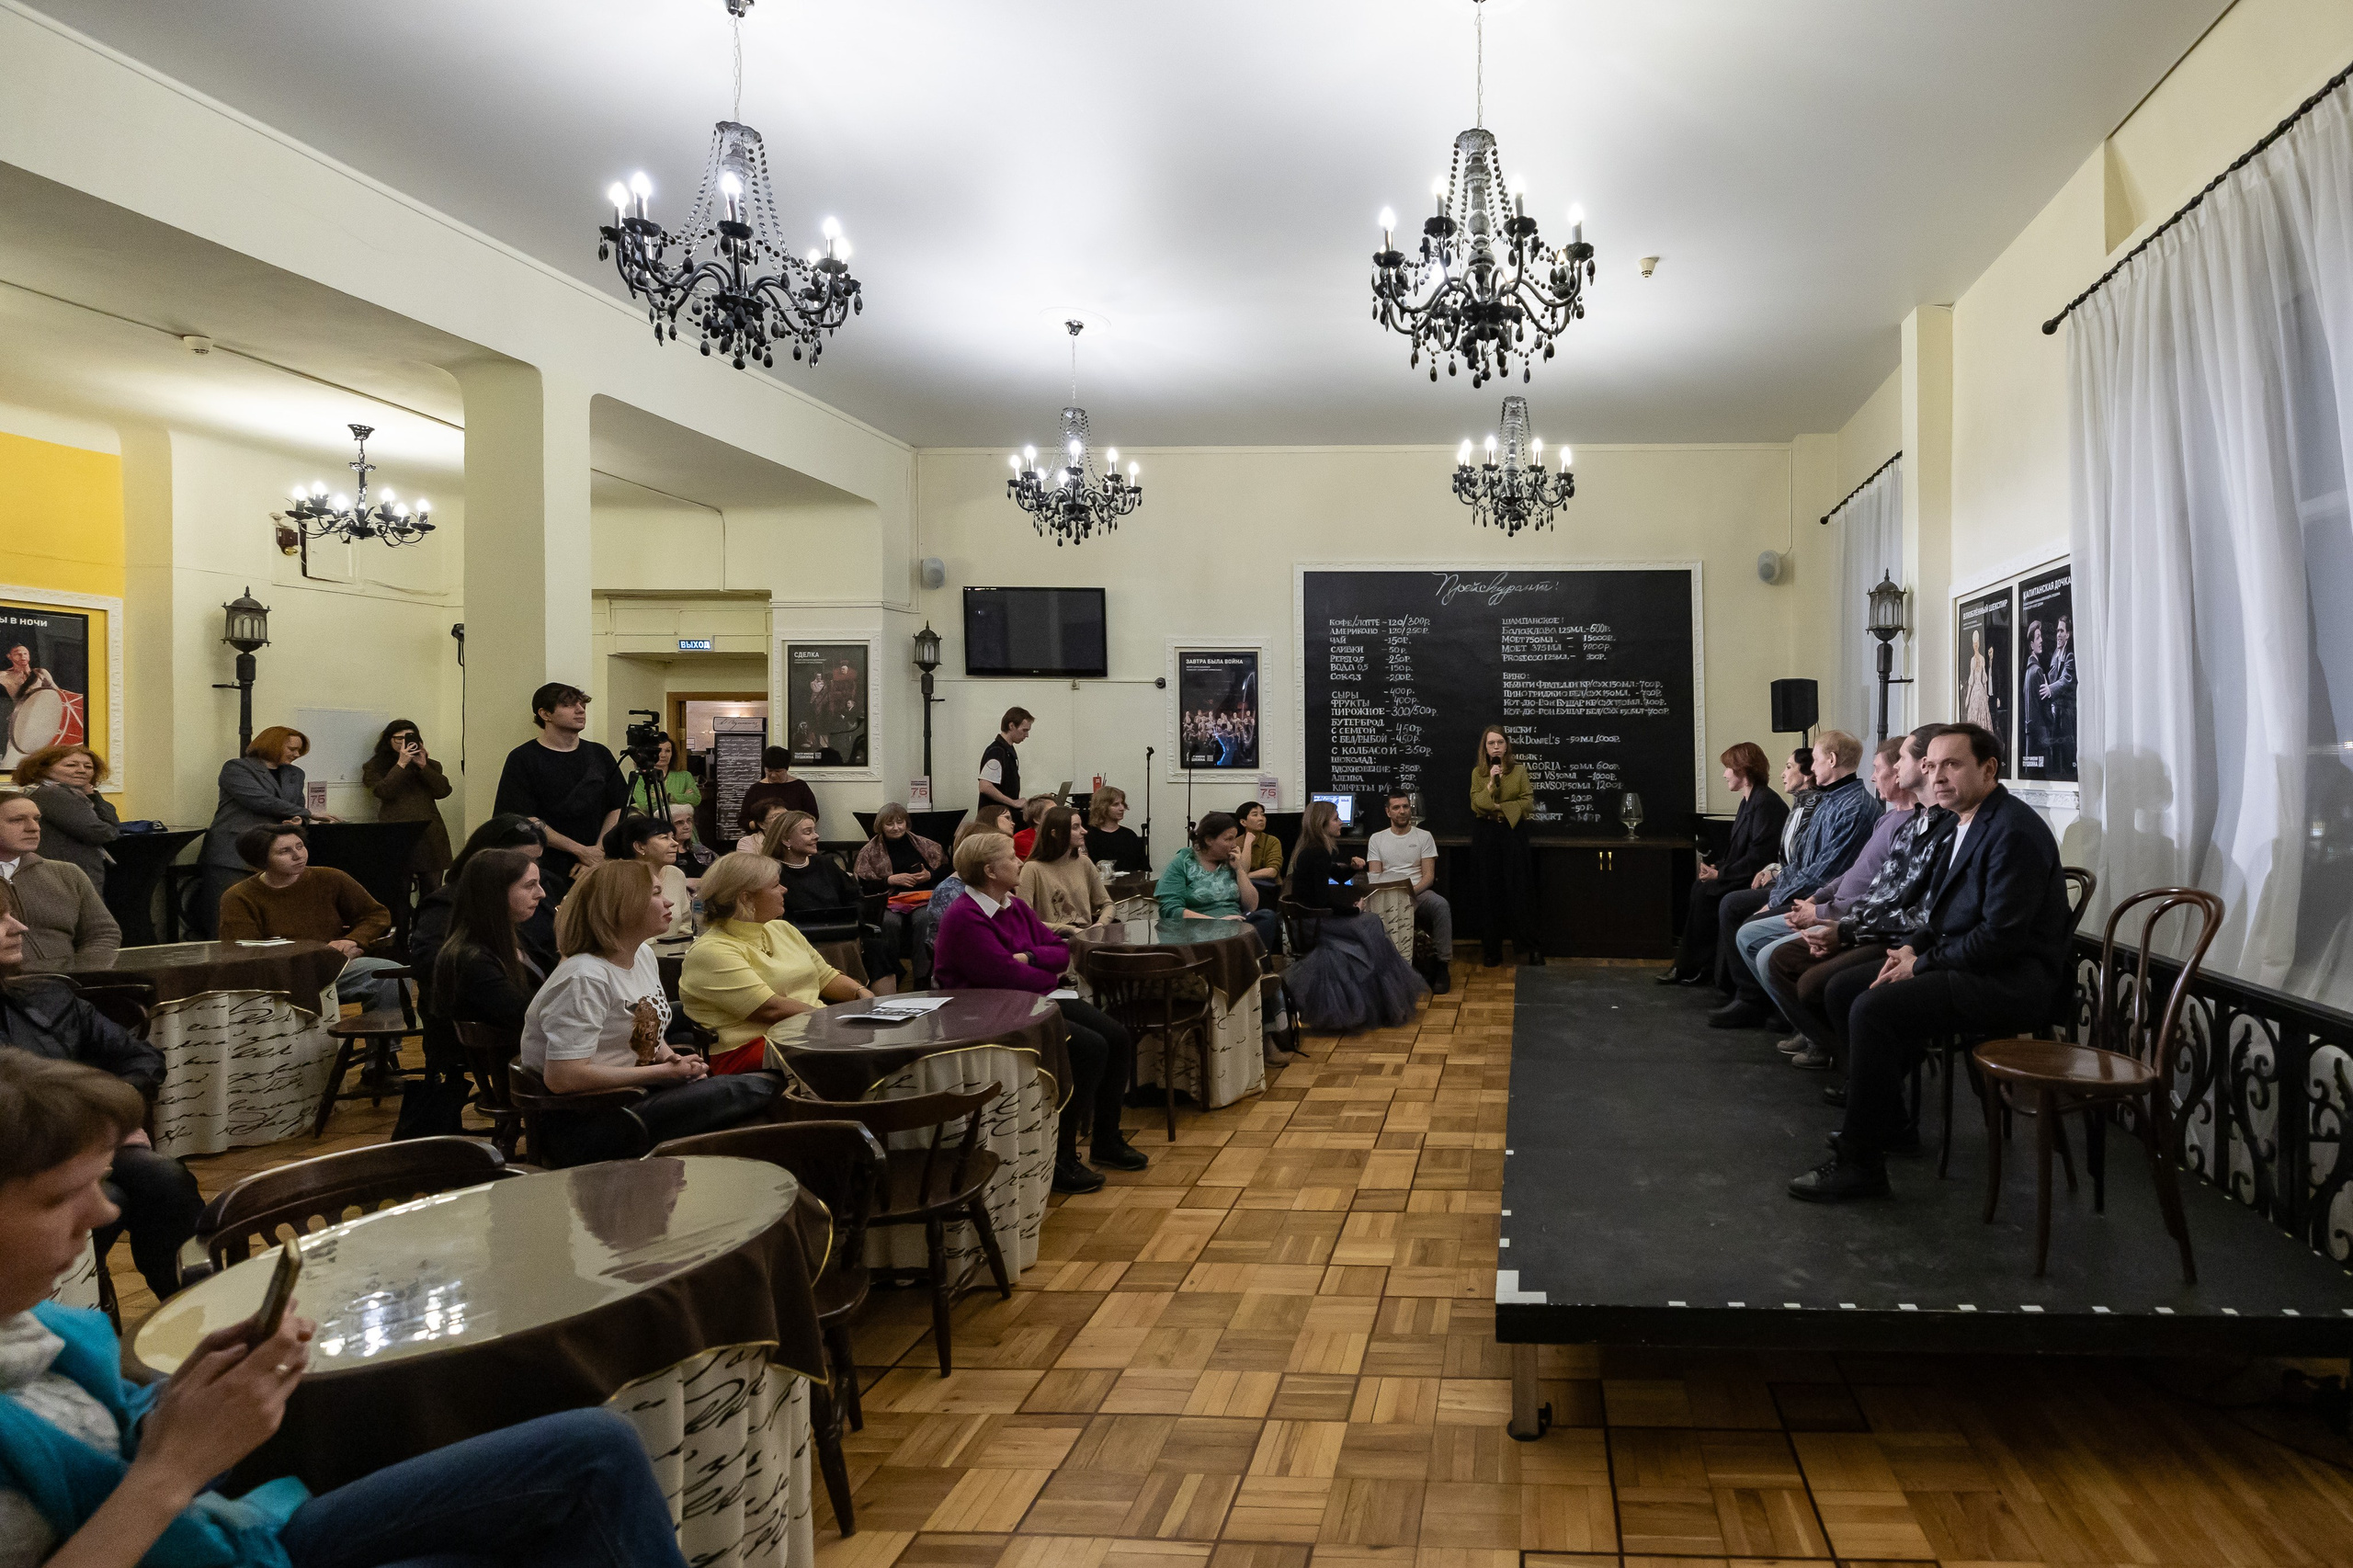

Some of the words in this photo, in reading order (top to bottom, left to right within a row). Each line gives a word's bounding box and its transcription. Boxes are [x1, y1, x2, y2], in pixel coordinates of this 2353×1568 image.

[2022, 581, 2054, 600] КАПИТАНСКАЯ
[19, 618, 48, 628] НОЧИ
[1329, 635, 1347, 644] ЧАЙ
[680, 641, 711, 650] ВЫХОД
[1330, 645, 1365, 653] СЛИВКИ
[793, 651, 820, 659] СДЕЛКА
[1331, 690, 1359, 699] СЫРЫ
[1330, 699, 1370, 708] ФРУКТЫ
[1331, 707, 1386, 716] ПИРОЖНОЕ
[1330, 718, 1385, 727] БУТЕРБРОД
[1338, 725, 1376, 734] СЕМГОЙ
[1331, 746, 1338, 755] С
[1342, 743, 1397, 755] КОЛБАСОЙ
[1331, 774, 1365, 782] АЛЕНКА
[910, 787, 928, 796] 75
[1332, 783, 1376, 792] КОНФЕТЫ
[1259, 788, 1277, 798] 75
[310, 794, 325, 804] 75
